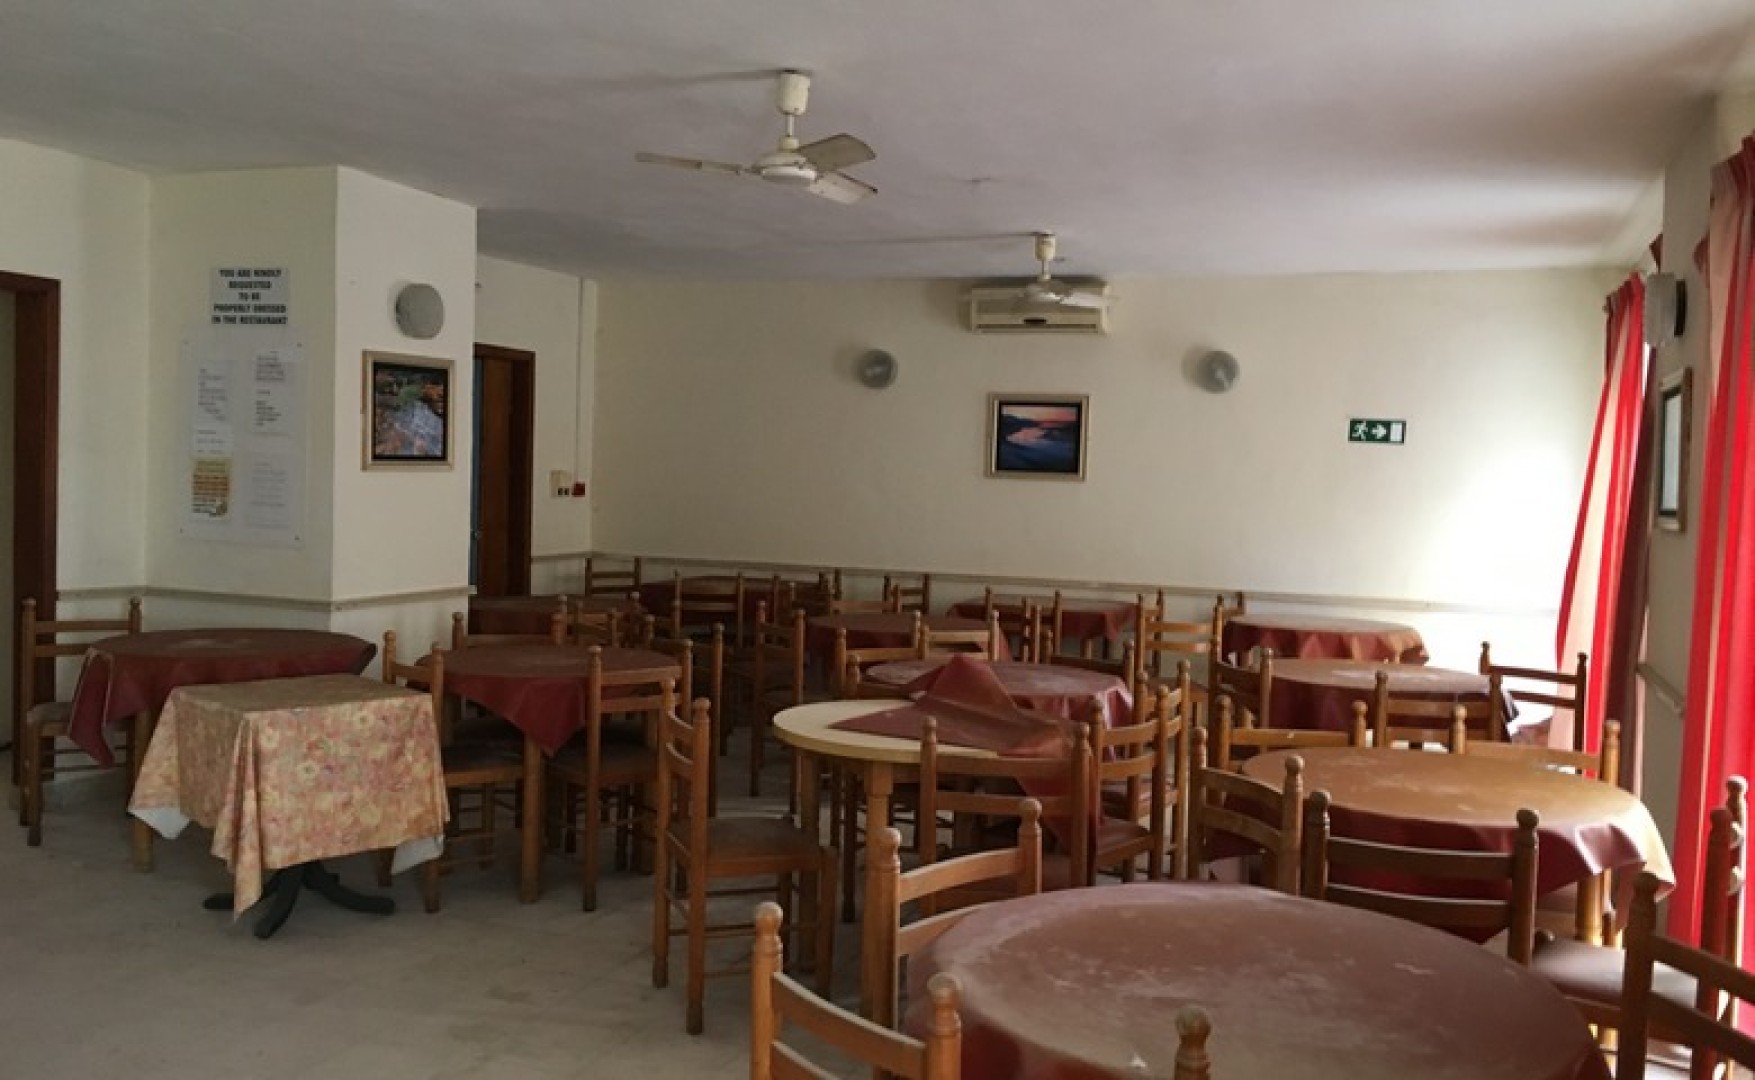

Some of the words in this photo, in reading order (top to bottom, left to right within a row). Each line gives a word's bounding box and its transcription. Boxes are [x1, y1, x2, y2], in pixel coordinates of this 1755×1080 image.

[219, 269, 235, 278] YOU
[238, 269, 251, 278] ARE
[253, 269, 282, 278] KINDLY
[228, 280, 271, 289] REQUESTED
[213, 304, 250, 313] PROPERLY
[253, 304, 287, 313] DRESSED
[211, 315, 221, 325] IN
[222, 315, 237, 325] THE
[240, 315, 288, 325] RESTAURANT
